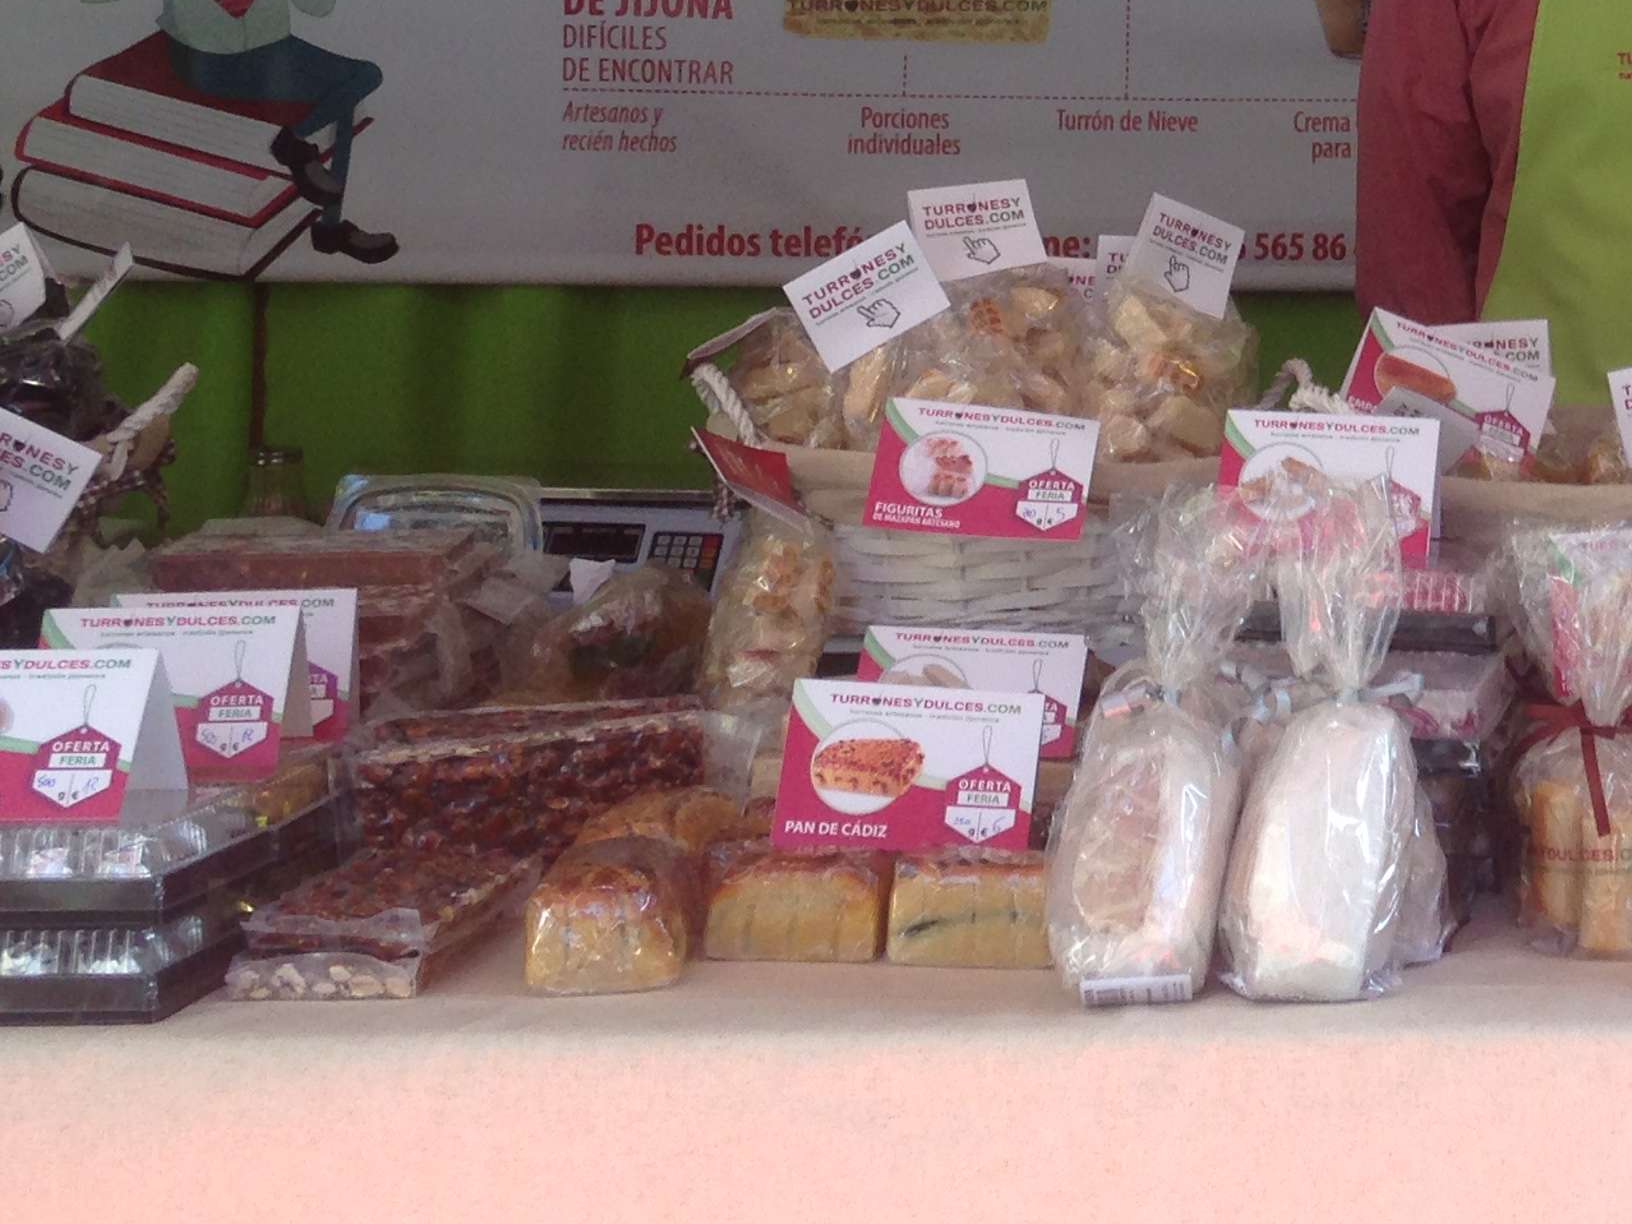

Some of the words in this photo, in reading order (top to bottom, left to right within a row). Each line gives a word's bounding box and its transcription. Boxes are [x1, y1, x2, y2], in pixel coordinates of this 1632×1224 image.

[563, 21, 667, 51] DIFÍCILES
[563, 56, 593, 82] DE
[599, 57, 734, 86] ENCONTRAR
[563, 102, 647, 126] Artesanos
[652, 108, 663, 132] y
[861, 106, 950, 129] Porciones
[1056, 108, 1111, 132] Turrón
[1115, 109, 1139, 132] de
[1144, 110, 1199, 133] Nieve
[1293, 111, 1351, 133] Crema
[563, 128, 613, 152] recién
[618, 129, 678, 153] hechos
[848, 133, 961, 156] individuales
[1311, 140, 1351, 163] para
[924, 209, 1024, 230] DULCES.COM
[635, 223, 761, 258] Pedidos
[1254, 232, 1304, 261] 565
[1312, 232, 1346, 261] 86
[1028, 479, 1076, 492] OFERTA
[874, 501, 943, 519] FIGURITAS
[210, 694, 264, 706] OFERTA
[217, 708, 252, 718] FERIA
[52, 741, 110, 753] OFERTA
[58, 755, 97, 766] FERIA
[958, 779, 1012, 793] OFERTA
[966, 794, 1001, 806] FERIA
[784, 820, 817, 834] PAN
[818, 821, 838, 835] DE
[841, 819, 888, 838] CÁDIZ
